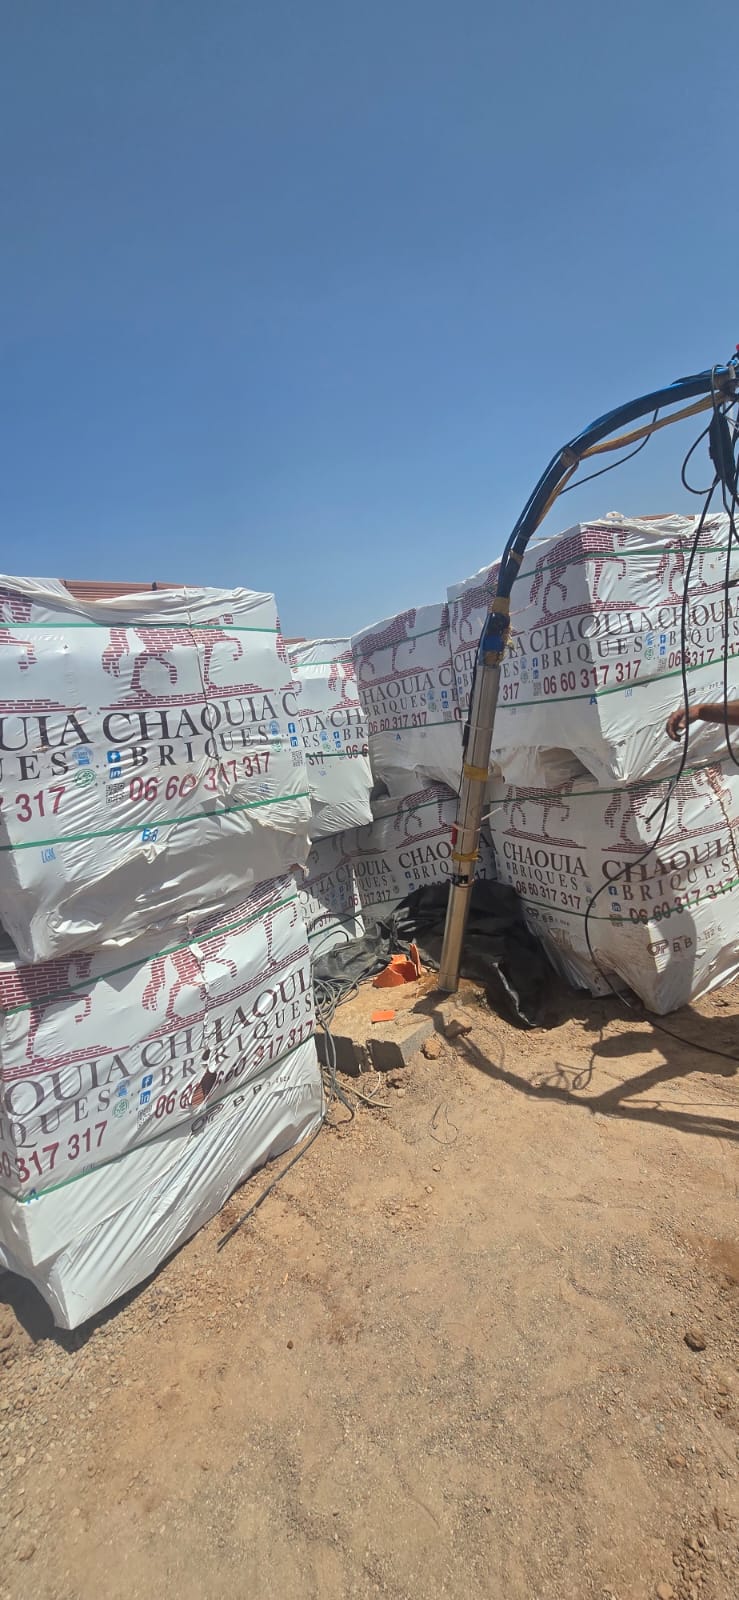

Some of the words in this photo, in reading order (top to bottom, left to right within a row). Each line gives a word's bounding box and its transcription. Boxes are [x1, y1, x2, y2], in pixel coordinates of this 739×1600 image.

[530, 612, 654, 653] CHAOUIA
[541, 636, 643, 671] BRIQUES
[503, 683, 519, 701] 317
[543, 675, 556, 695] 06
[560, 671, 576, 692] 60
[581, 664, 610, 688] 317
[615, 659, 641, 683] 317
[102, 695, 279, 743] CHAOUIA
[392, 713, 409, 730] 317
[411, 711, 428, 728] 317
[128, 724, 269, 768] BRIQUES
[15, 786, 66, 822] 317
[129, 776, 159, 802] 06
[165, 773, 197, 801] 60
[203, 760, 238, 792] 317
[243, 751, 271, 778] 317
[398, 841, 452, 869] CHAO
[503, 841, 589, 879] CHAOUIA
[511, 861, 579, 892] BRIQUES
[622, 857, 731, 902] BRIQUES
[540, 886, 558, 902] 317
[560, 891, 581, 910] 317
[15, 1141, 59, 1183] 317
[67, 1119, 108, 1162] 317
[155, 1089, 178, 1119] 06
[287, 1020, 314, 1050] 317
